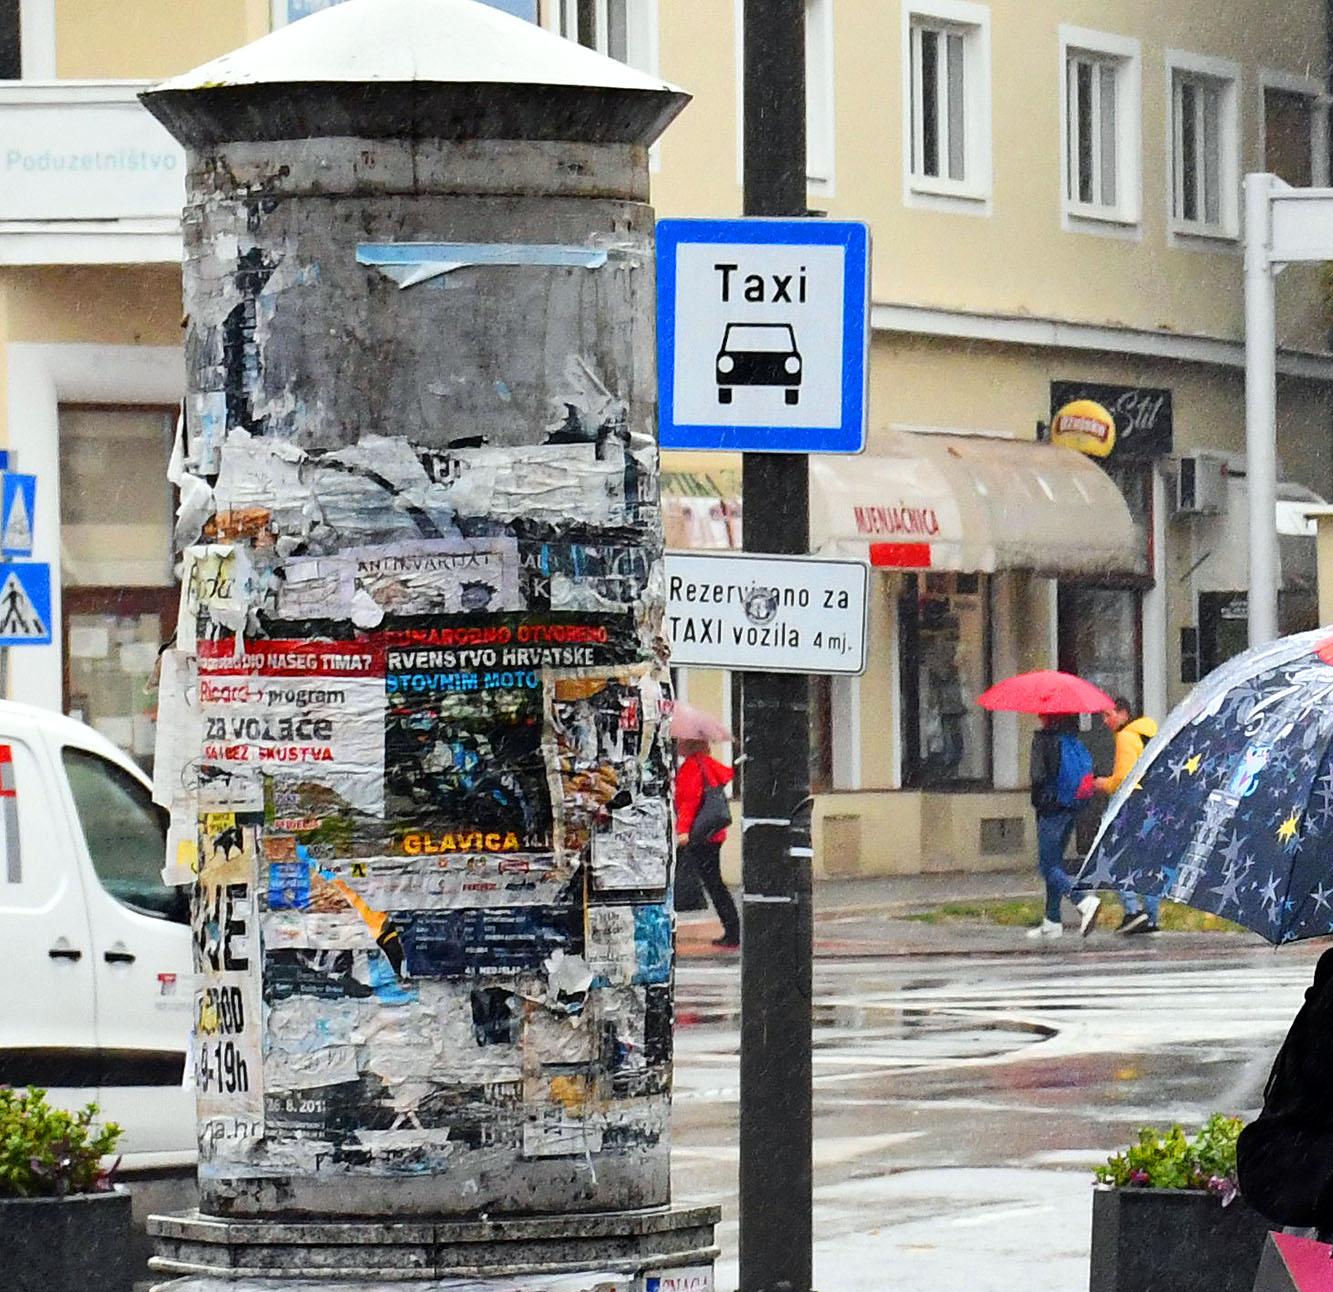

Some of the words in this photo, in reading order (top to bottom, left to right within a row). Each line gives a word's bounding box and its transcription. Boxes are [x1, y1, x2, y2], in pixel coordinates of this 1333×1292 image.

[6, 149, 177, 171] Poduzetništvo
[714, 263, 808, 304] Taxi
[669, 576, 810, 608] Rezervano
[823, 589, 849, 609] za
[669, 616, 722, 645] TAXI
[733, 622, 800, 648] vozila
[813, 632, 822, 649] 4
[828, 632, 852, 655] mj.
[321, 655, 372, 671] TIMA?
[502, 647, 595, 667] HRVATSKE
[268, 687, 345, 707] program
[403, 832, 519, 854] GLAVICA
